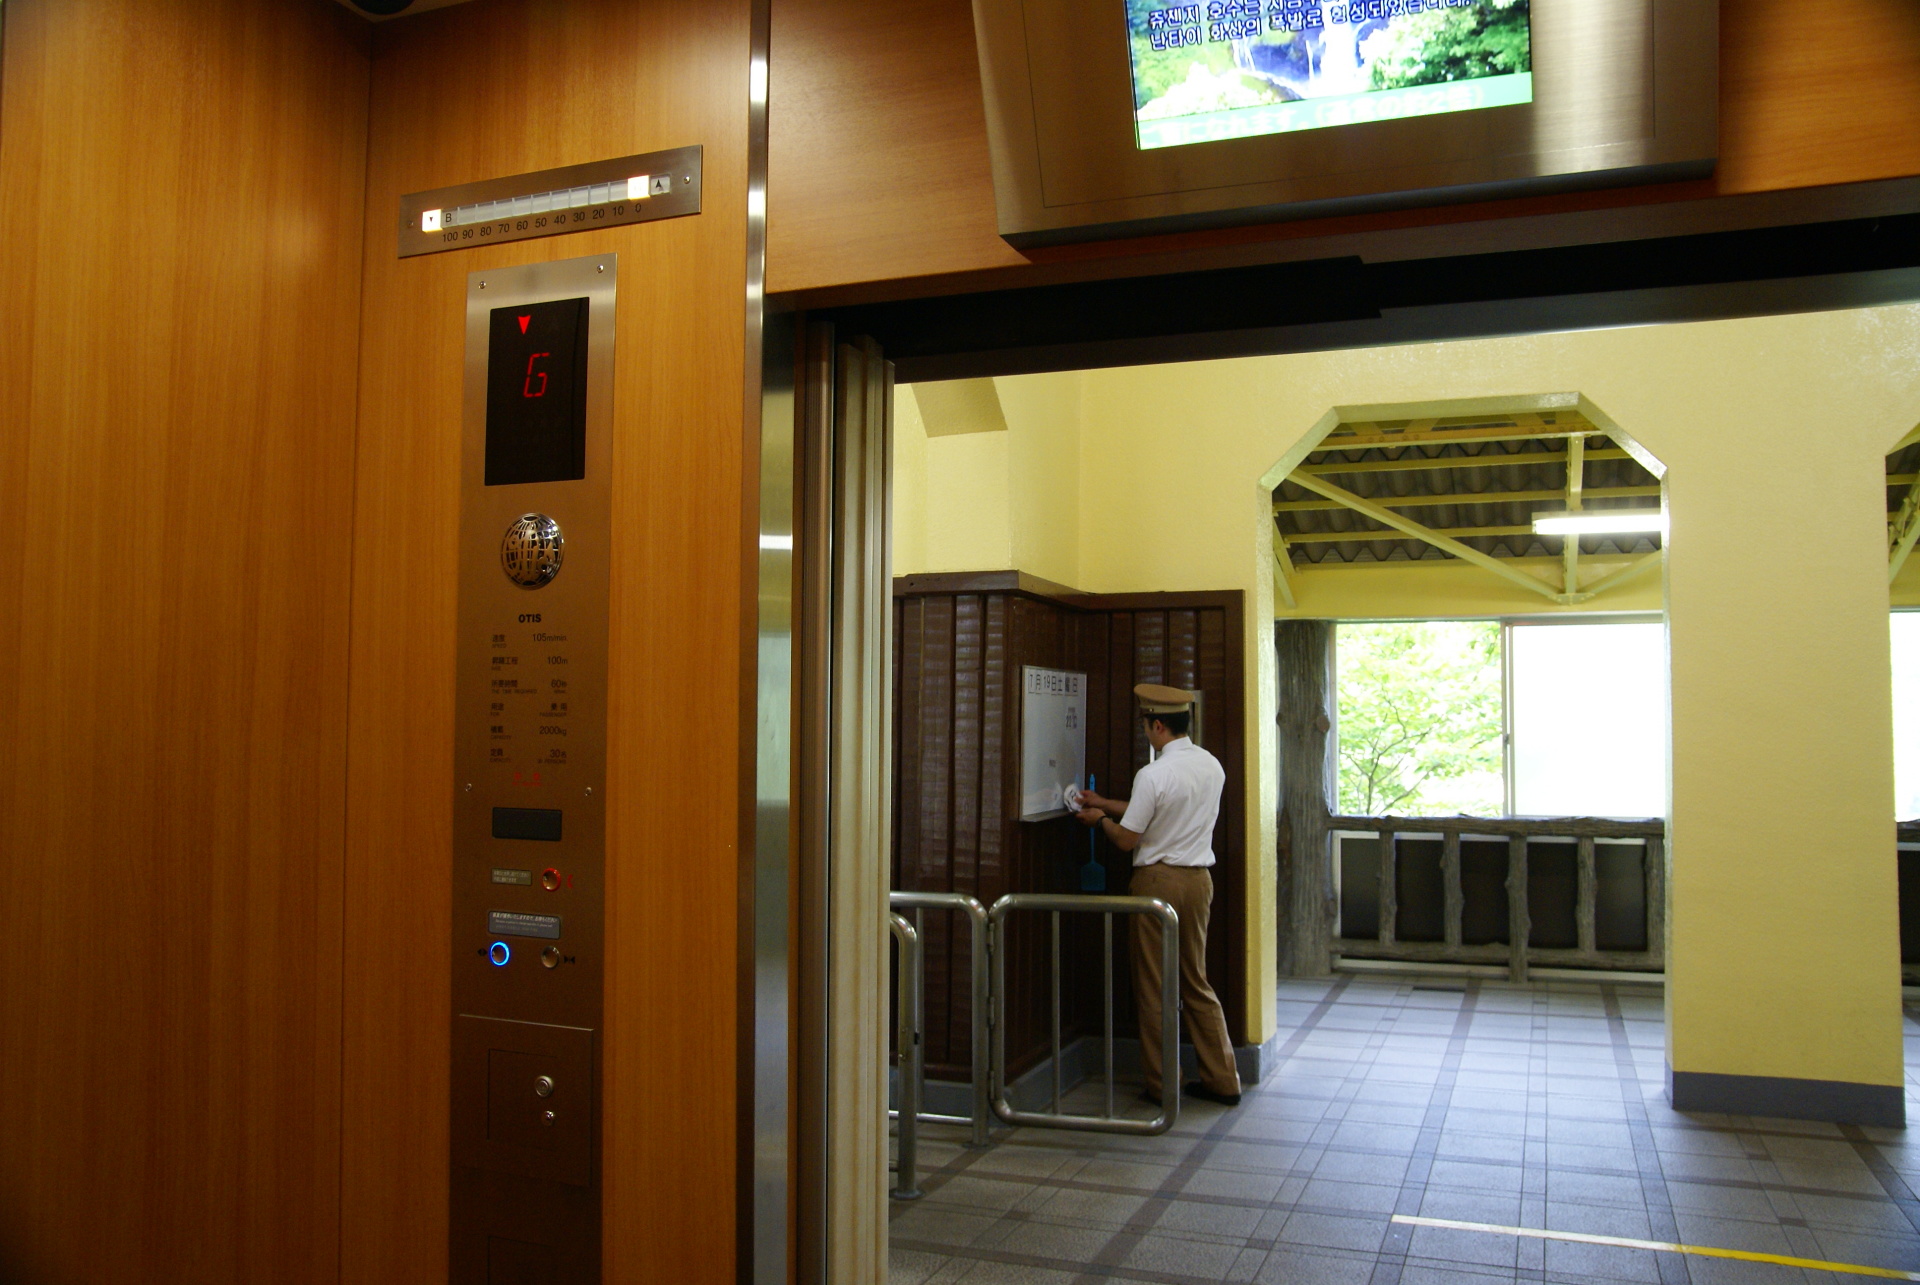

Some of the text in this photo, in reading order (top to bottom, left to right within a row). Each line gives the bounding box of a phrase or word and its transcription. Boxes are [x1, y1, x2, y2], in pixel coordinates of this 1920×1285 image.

[1149, 5, 1201, 30] 쥬젠지
[1150, 26, 1202, 51] 난타이
[1209, 16, 1262, 42] 화산의
[1268, 8, 1324, 33] 폭발로
[442, 203, 642, 242] 100 90 80 70 60 50 40 30 20 10 0
[445, 212, 452, 222] B
[518, 613, 542, 623] OTIS
[547, 656, 568, 665] 100m
[540, 725, 567, 736] 2000kg
